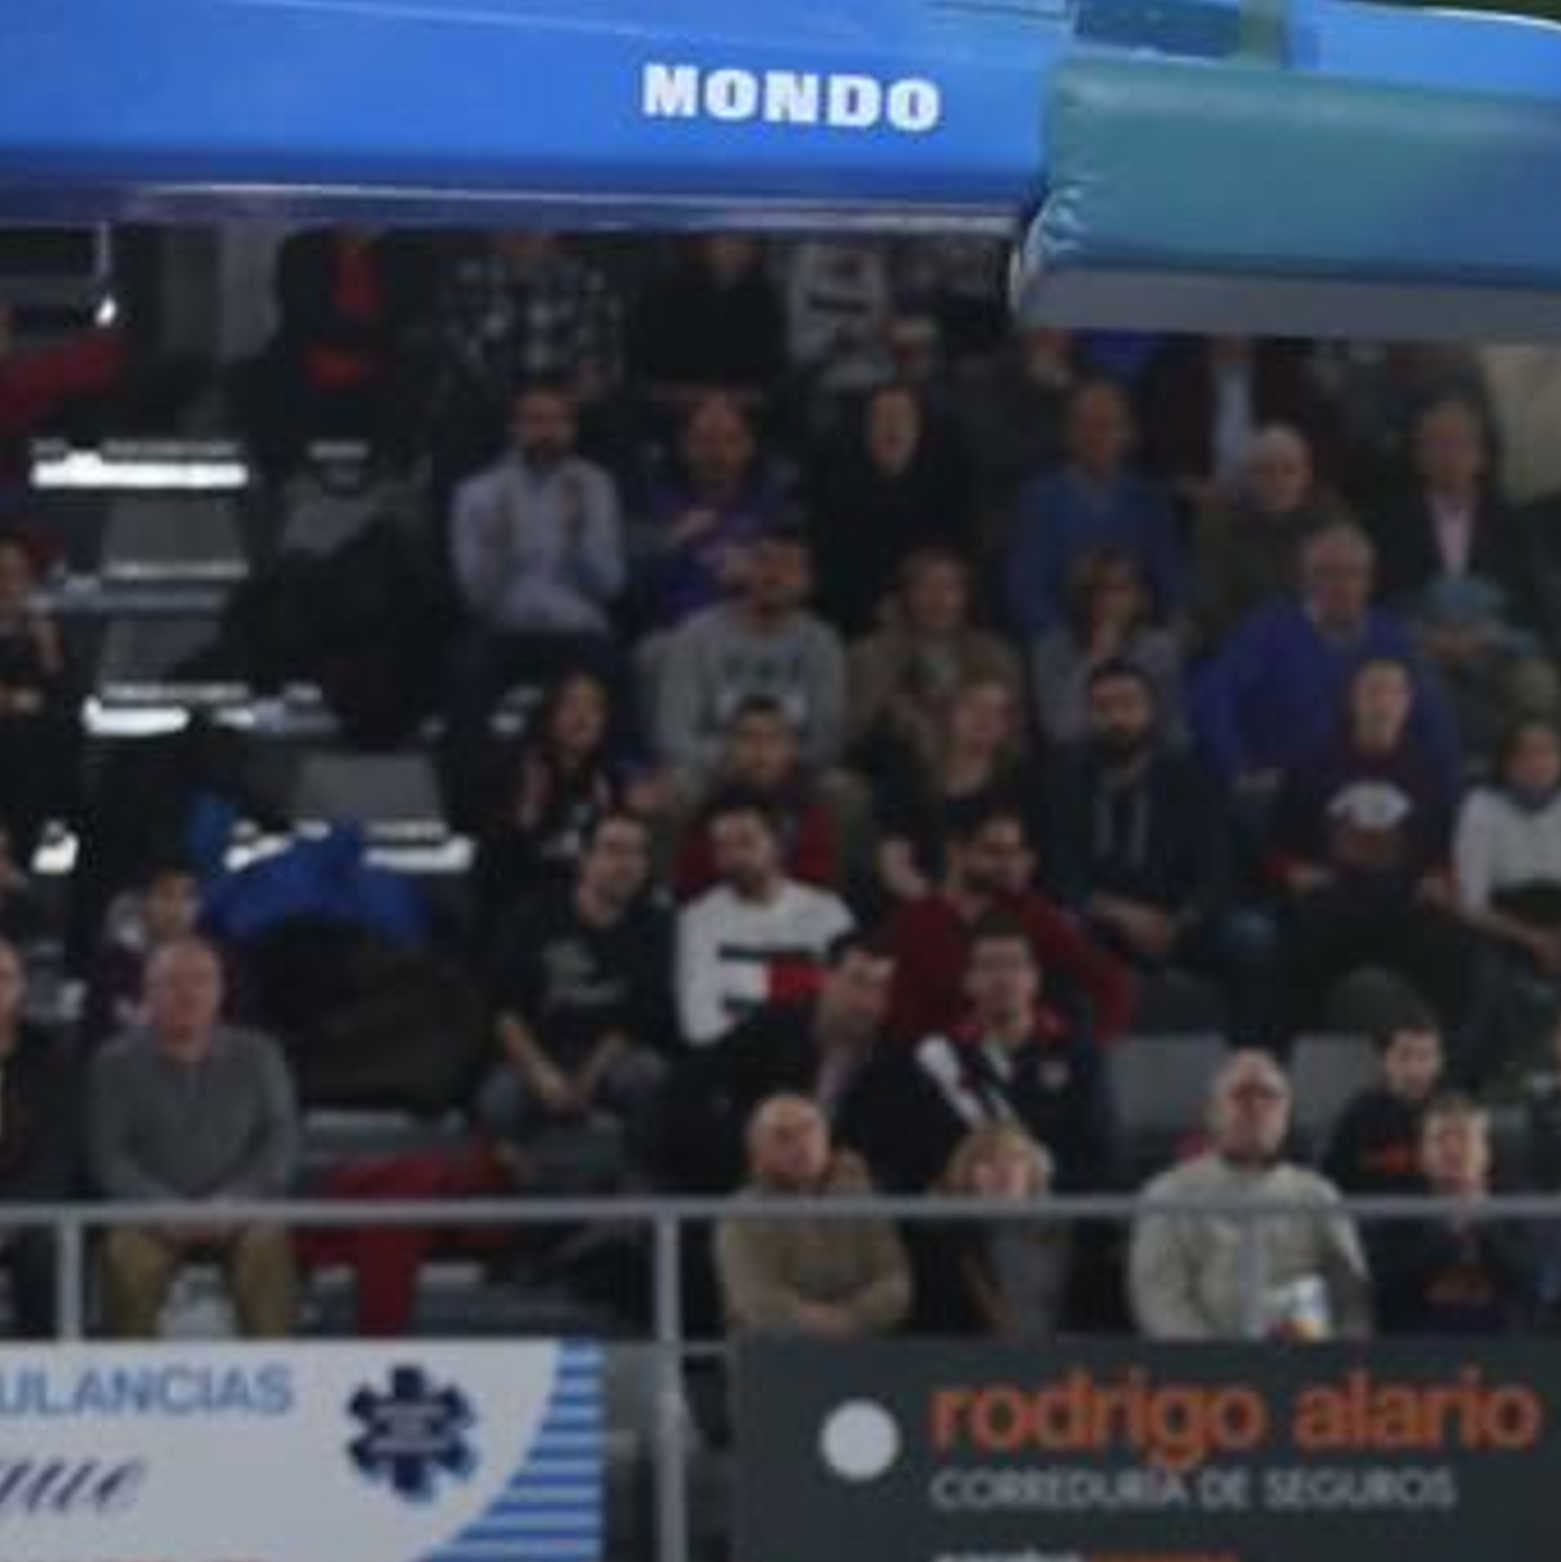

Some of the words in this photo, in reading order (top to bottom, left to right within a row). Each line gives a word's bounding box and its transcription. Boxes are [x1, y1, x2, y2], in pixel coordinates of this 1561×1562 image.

[642, 61, 941, 133] MONDO
[928, 1364, 1266, 1471] rodrigo
[1292, 1364, 1541, 1451] alario
